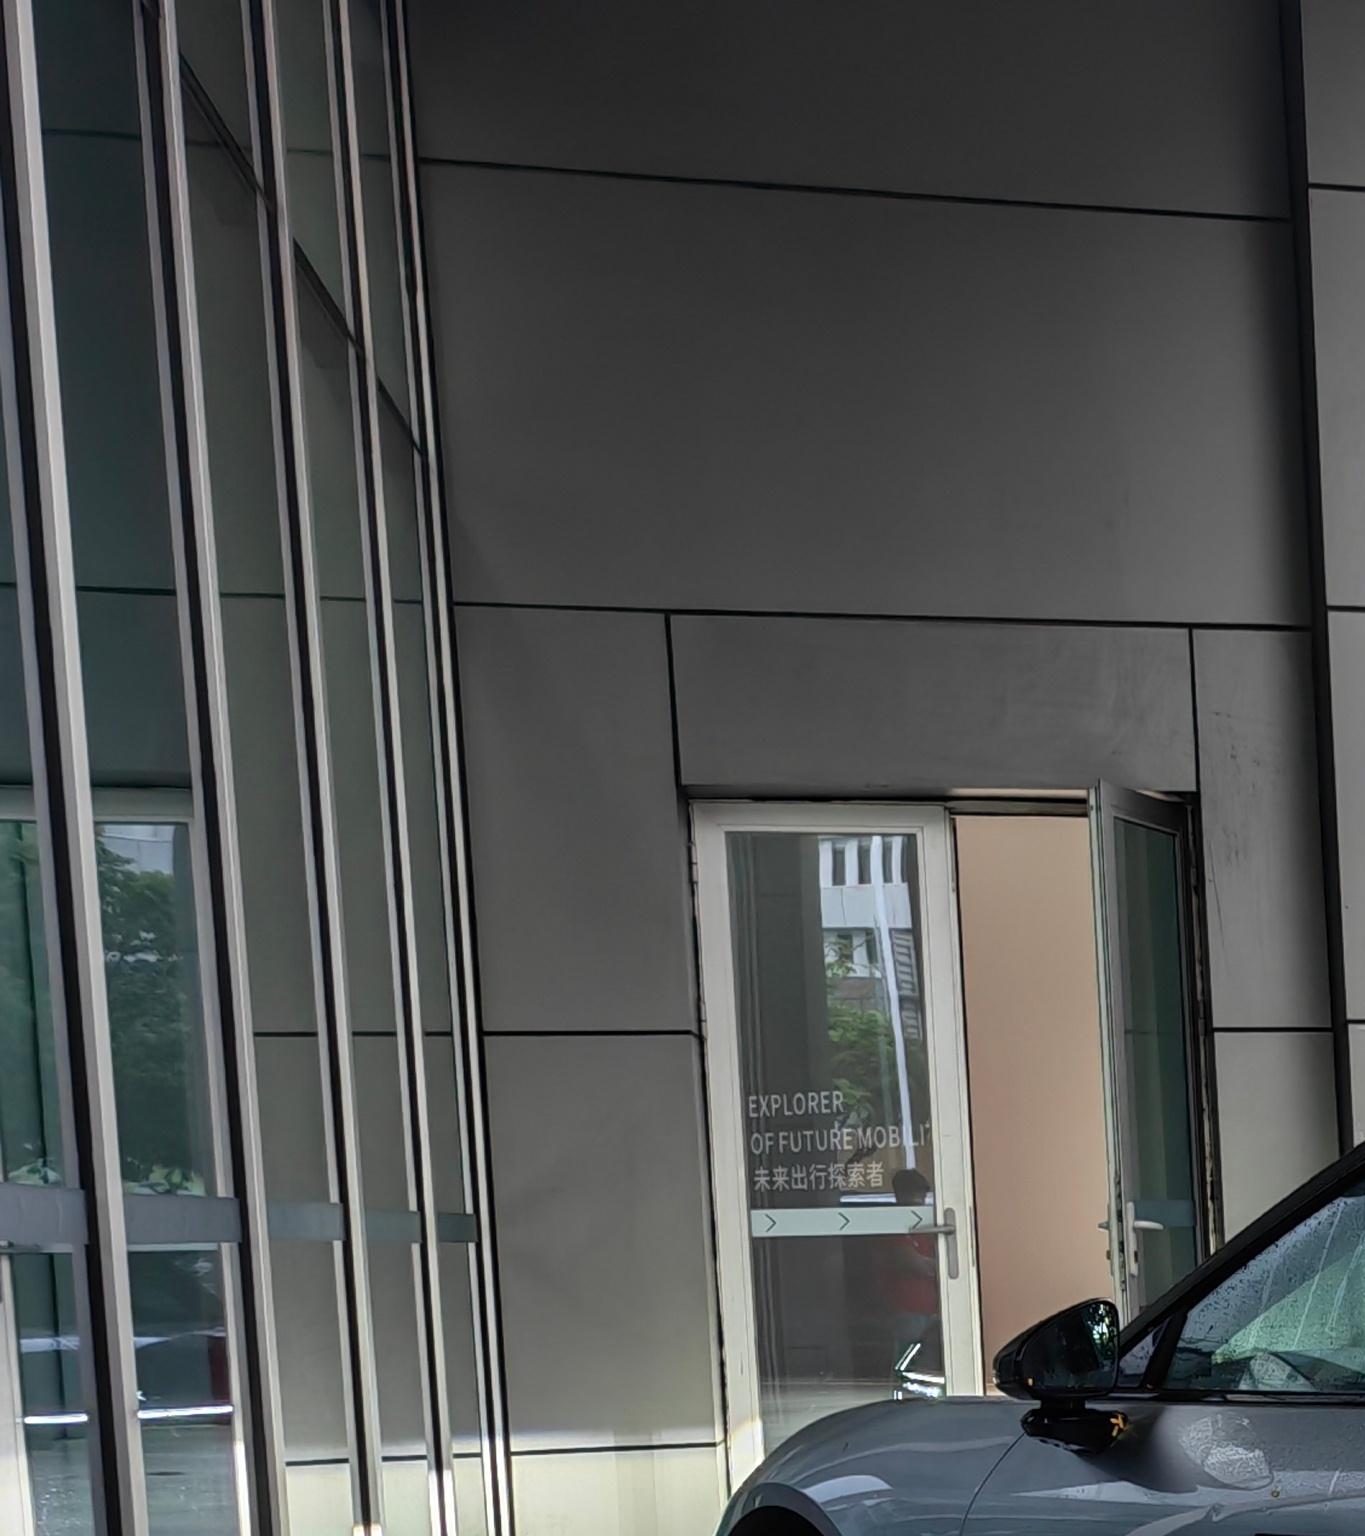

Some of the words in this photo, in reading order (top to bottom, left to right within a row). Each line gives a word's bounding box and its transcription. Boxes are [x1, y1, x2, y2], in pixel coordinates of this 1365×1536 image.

[748, 1090, 844, 1118] EXPLORER
[750, 1132, 775, 1155] OF
[779, 1128, 853, 1153] FUTURE
[857, 1122, 931, 1151] MOBI
[753, 1160, 885, 1193] 未来出行探索者
